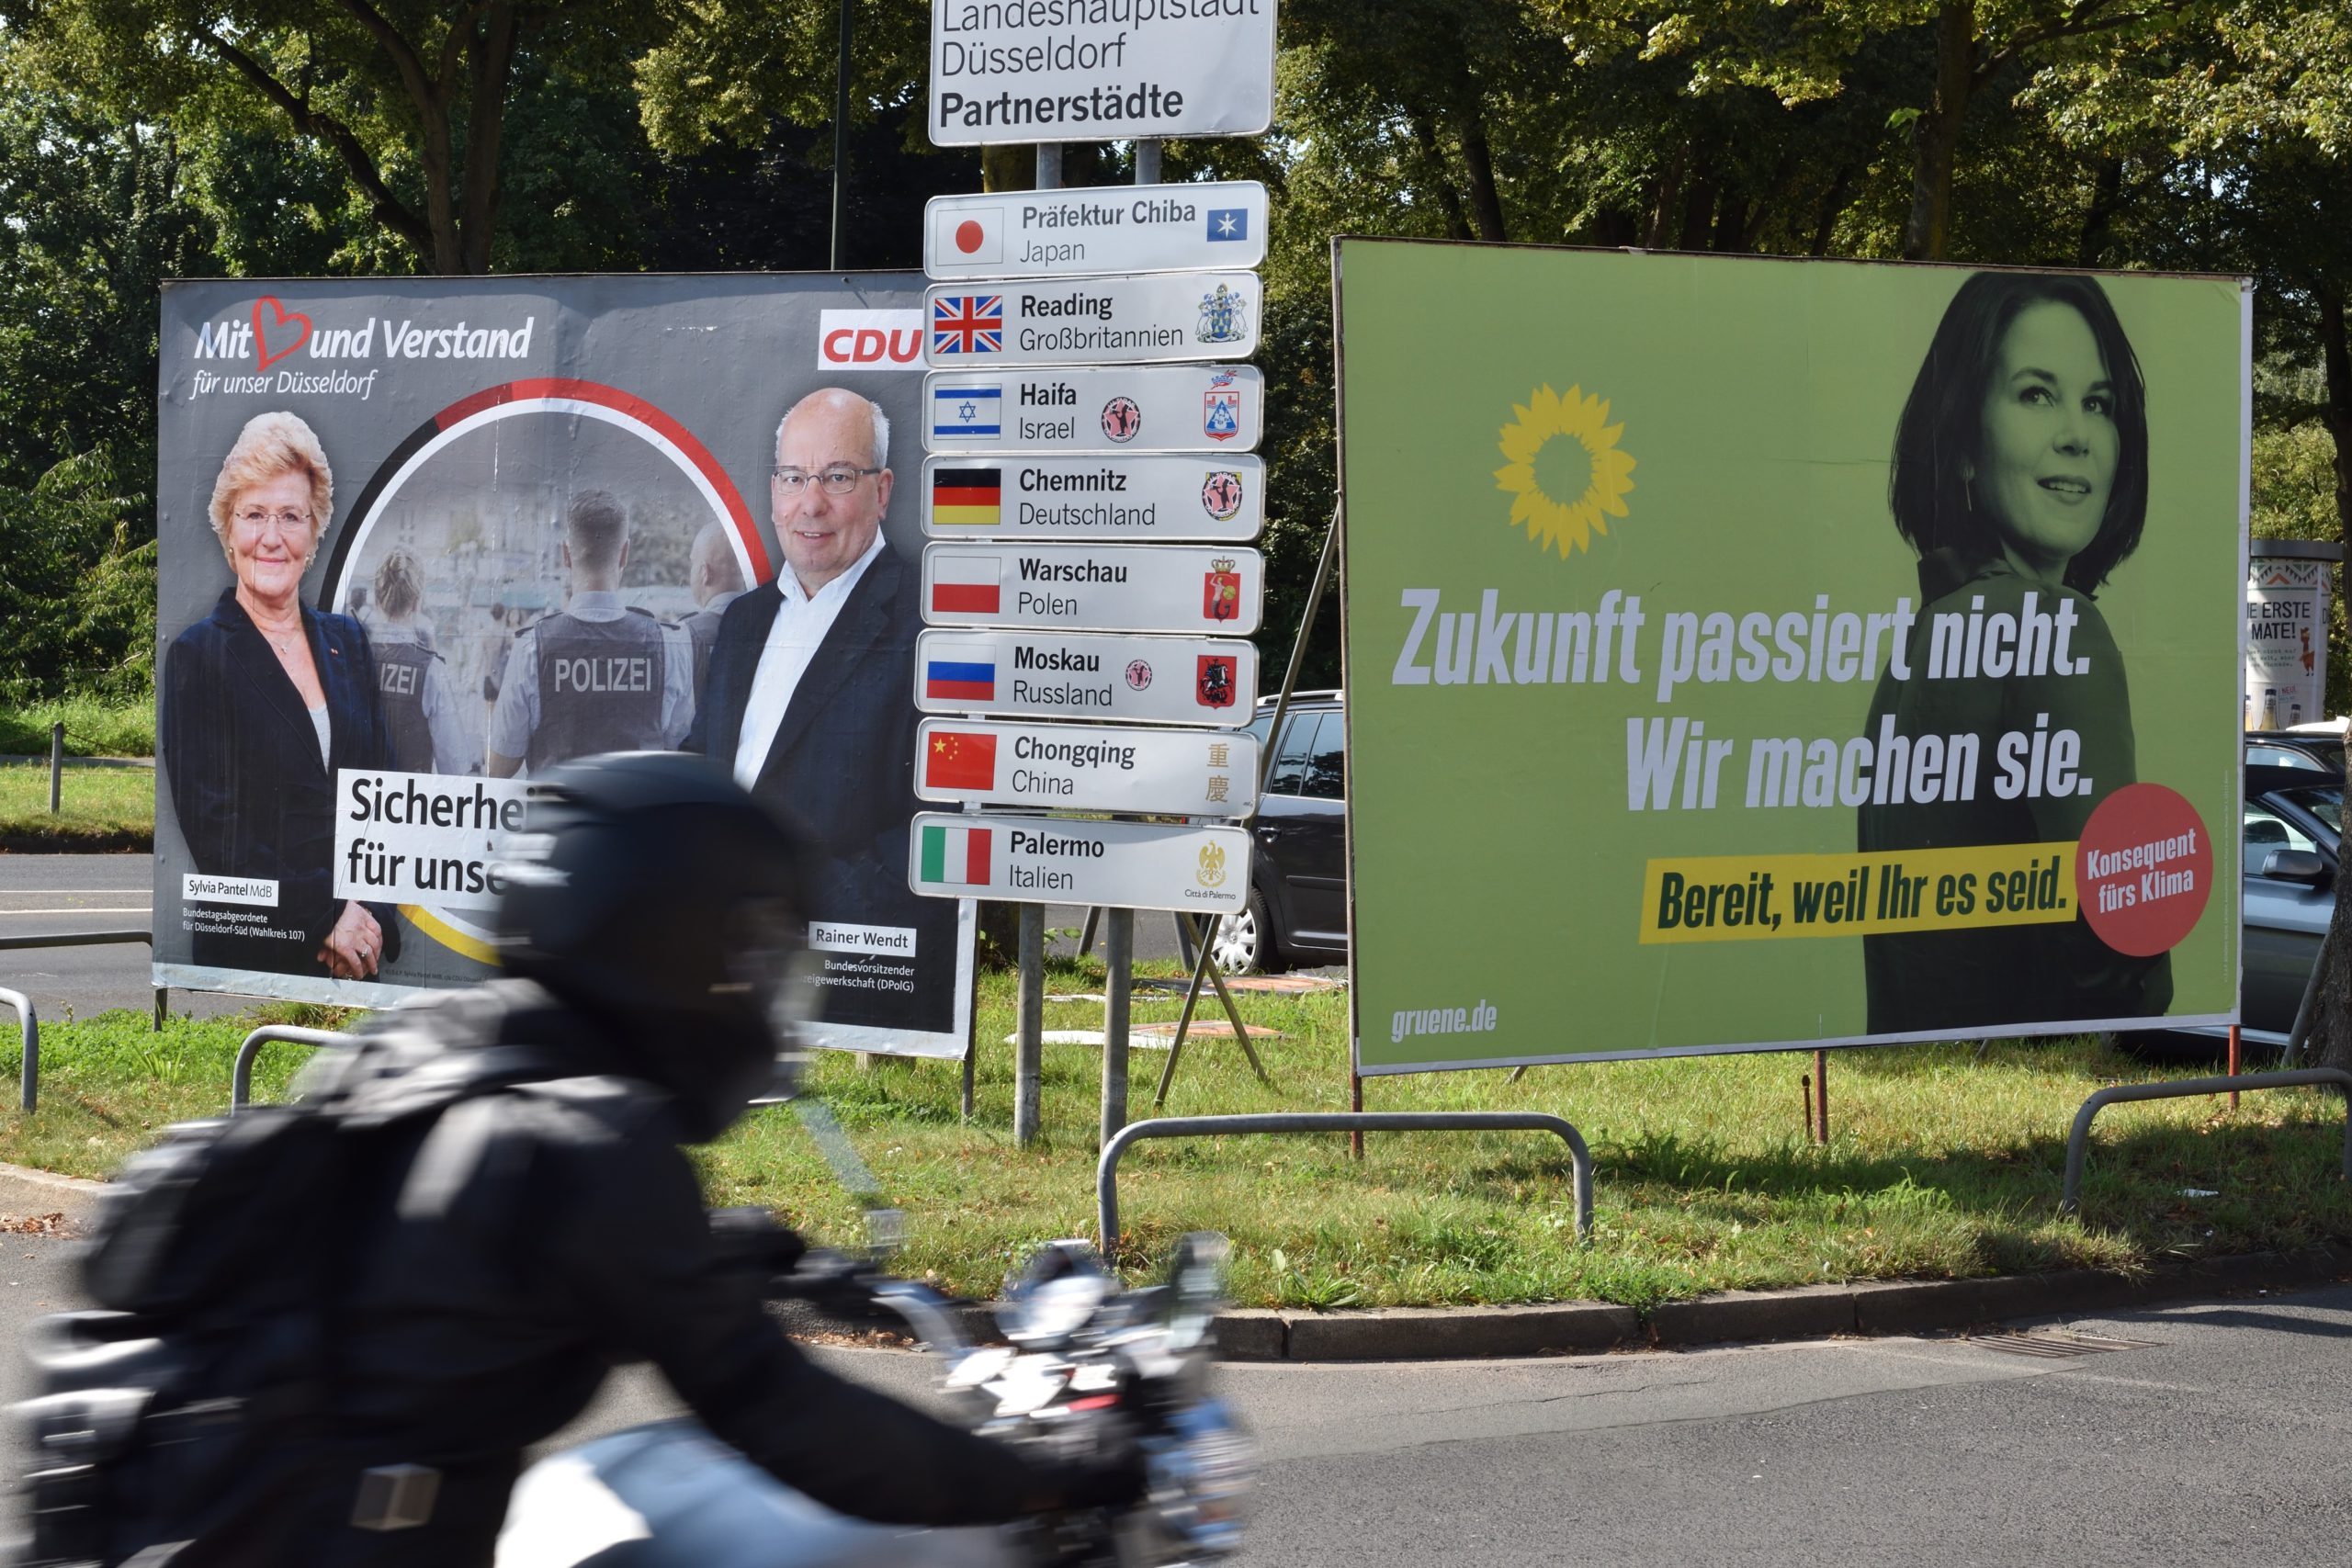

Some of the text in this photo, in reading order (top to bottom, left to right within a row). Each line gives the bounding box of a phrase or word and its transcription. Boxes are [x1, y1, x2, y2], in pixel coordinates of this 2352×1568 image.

[943, 32, 1126, 76] Düsseldorf
[940, 83, 1183, 128] Partnerstädte
[1023, 199, 1196, 229] Präfektur Chiba
[1020, 240, 1085, 267] Japan
[1021, 292, 1114, 320] Reading
[194, 316, 535, 359] Mit und Verstand
[823, 329, 923, 363] CDU
[1020, 324, 1183, 351] Großbritannien
[189, 369, 378, 400] für unser Düsseldorf
[1020, 382, 1077, 406] Haifa
[1020, 416, 1075, 440] Israel
[1019, 468, 1127, 491] Chemnitz
[1019, 502, 1156, 526] Deutschland
[1019, 558, 1127, 583] Warschau
[1018, 592, 1078, 615] Polen
[2262, 601, 2311, 619] ERSTE
[2252, 622, 2296, 640] MATE!
[1014, 646, 1100, 672] Moskau
[1391, 588, 2090, 704] Zukunft passiert nicht.
[379, 662, 417, 695] IZEI
[555, 658, 651, 692] POLIZEI
[1013, 680, 1113, 706] Russland
[1014, 736, 1136, 770] Chongqing
[1626, 713, 2093, 811] Wir machen sie.
[1012, 769, 1073, 795] China
[350, 777, 528, 832] Sicherhe
[1011, 830, 1105, 859] Palermo
[2087, 828, 2197, 881] Konsequent
[347, 838, 405, 886] für
[189, 880, 273, 898] Sylvia Pantel MdB
[1010, 864, 1073, 890] Italien
[1202, 890, 1208, 898] di
[1208, 890, 1237, 900] Palermo
[1657, 855, 2067, 933] Bereit, weil Ihr es seid.
[2098, 870, 2194, 913] fürs Klima
[183, 908, 268, 924] Bundestagsabgeordnete
[183, 920, 305, 942] für Düsseldorf-Süd (Wahlkreis 107)
[816, 929, 909, 948] Rainer Wendt
[824, 960, 915, 976] Bundesvorsitzender
[877, 979, 914, 993] (DPolG)
[1391, 998, 1498, 1043] gruene.de
